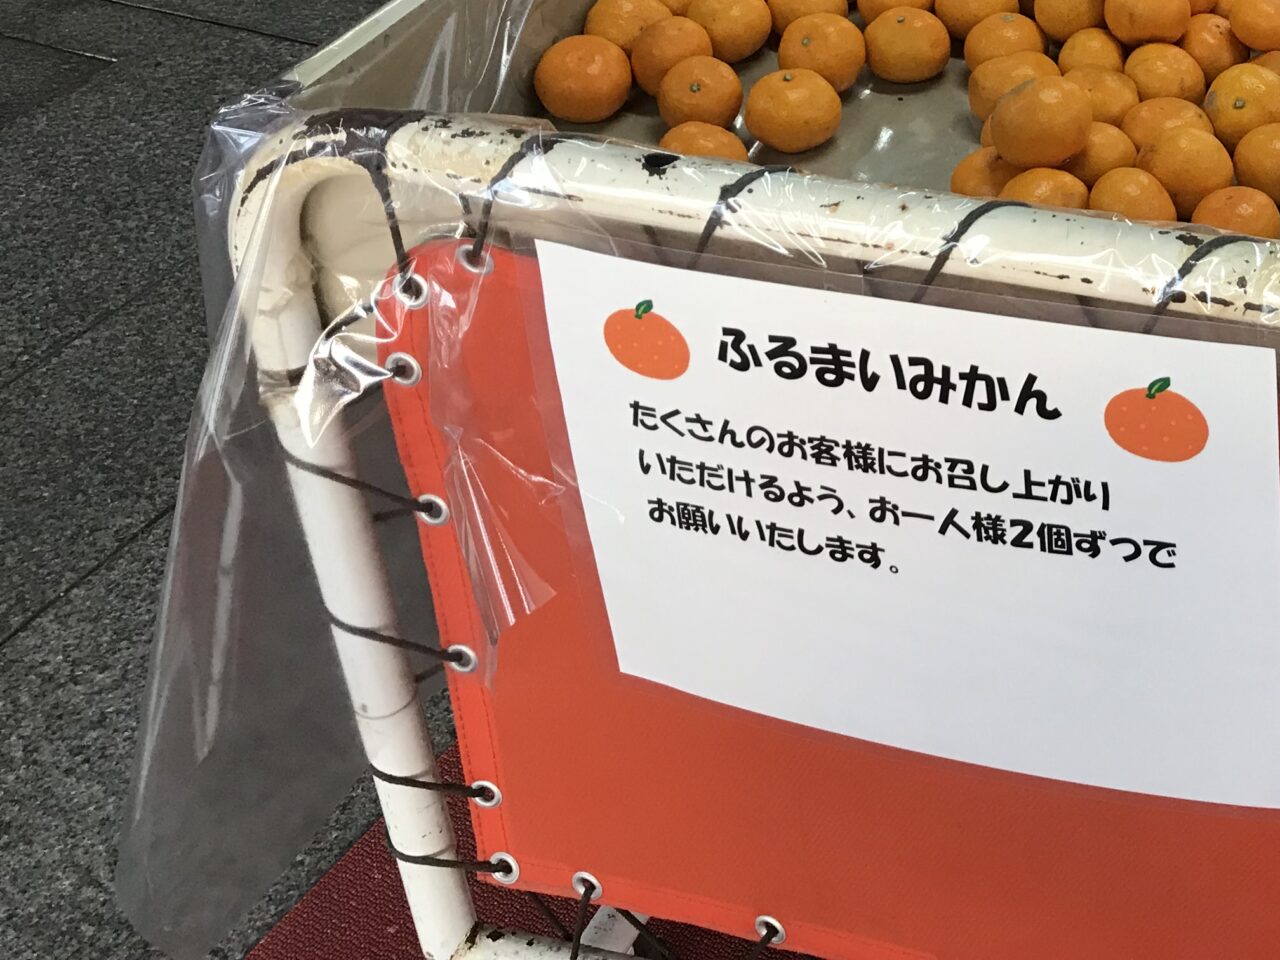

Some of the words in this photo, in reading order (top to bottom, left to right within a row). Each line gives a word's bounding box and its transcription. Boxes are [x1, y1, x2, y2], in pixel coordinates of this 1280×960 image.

[718, 326, 1063, 422] ふるまいみかん
[628, 400, 1111, 511] たくさんのお客様にお召し上がり
[638, 448, 1178, 569] いただけるよう、お一人様2個ずつで
[647, 497, 900, 575] お願いいたします。
